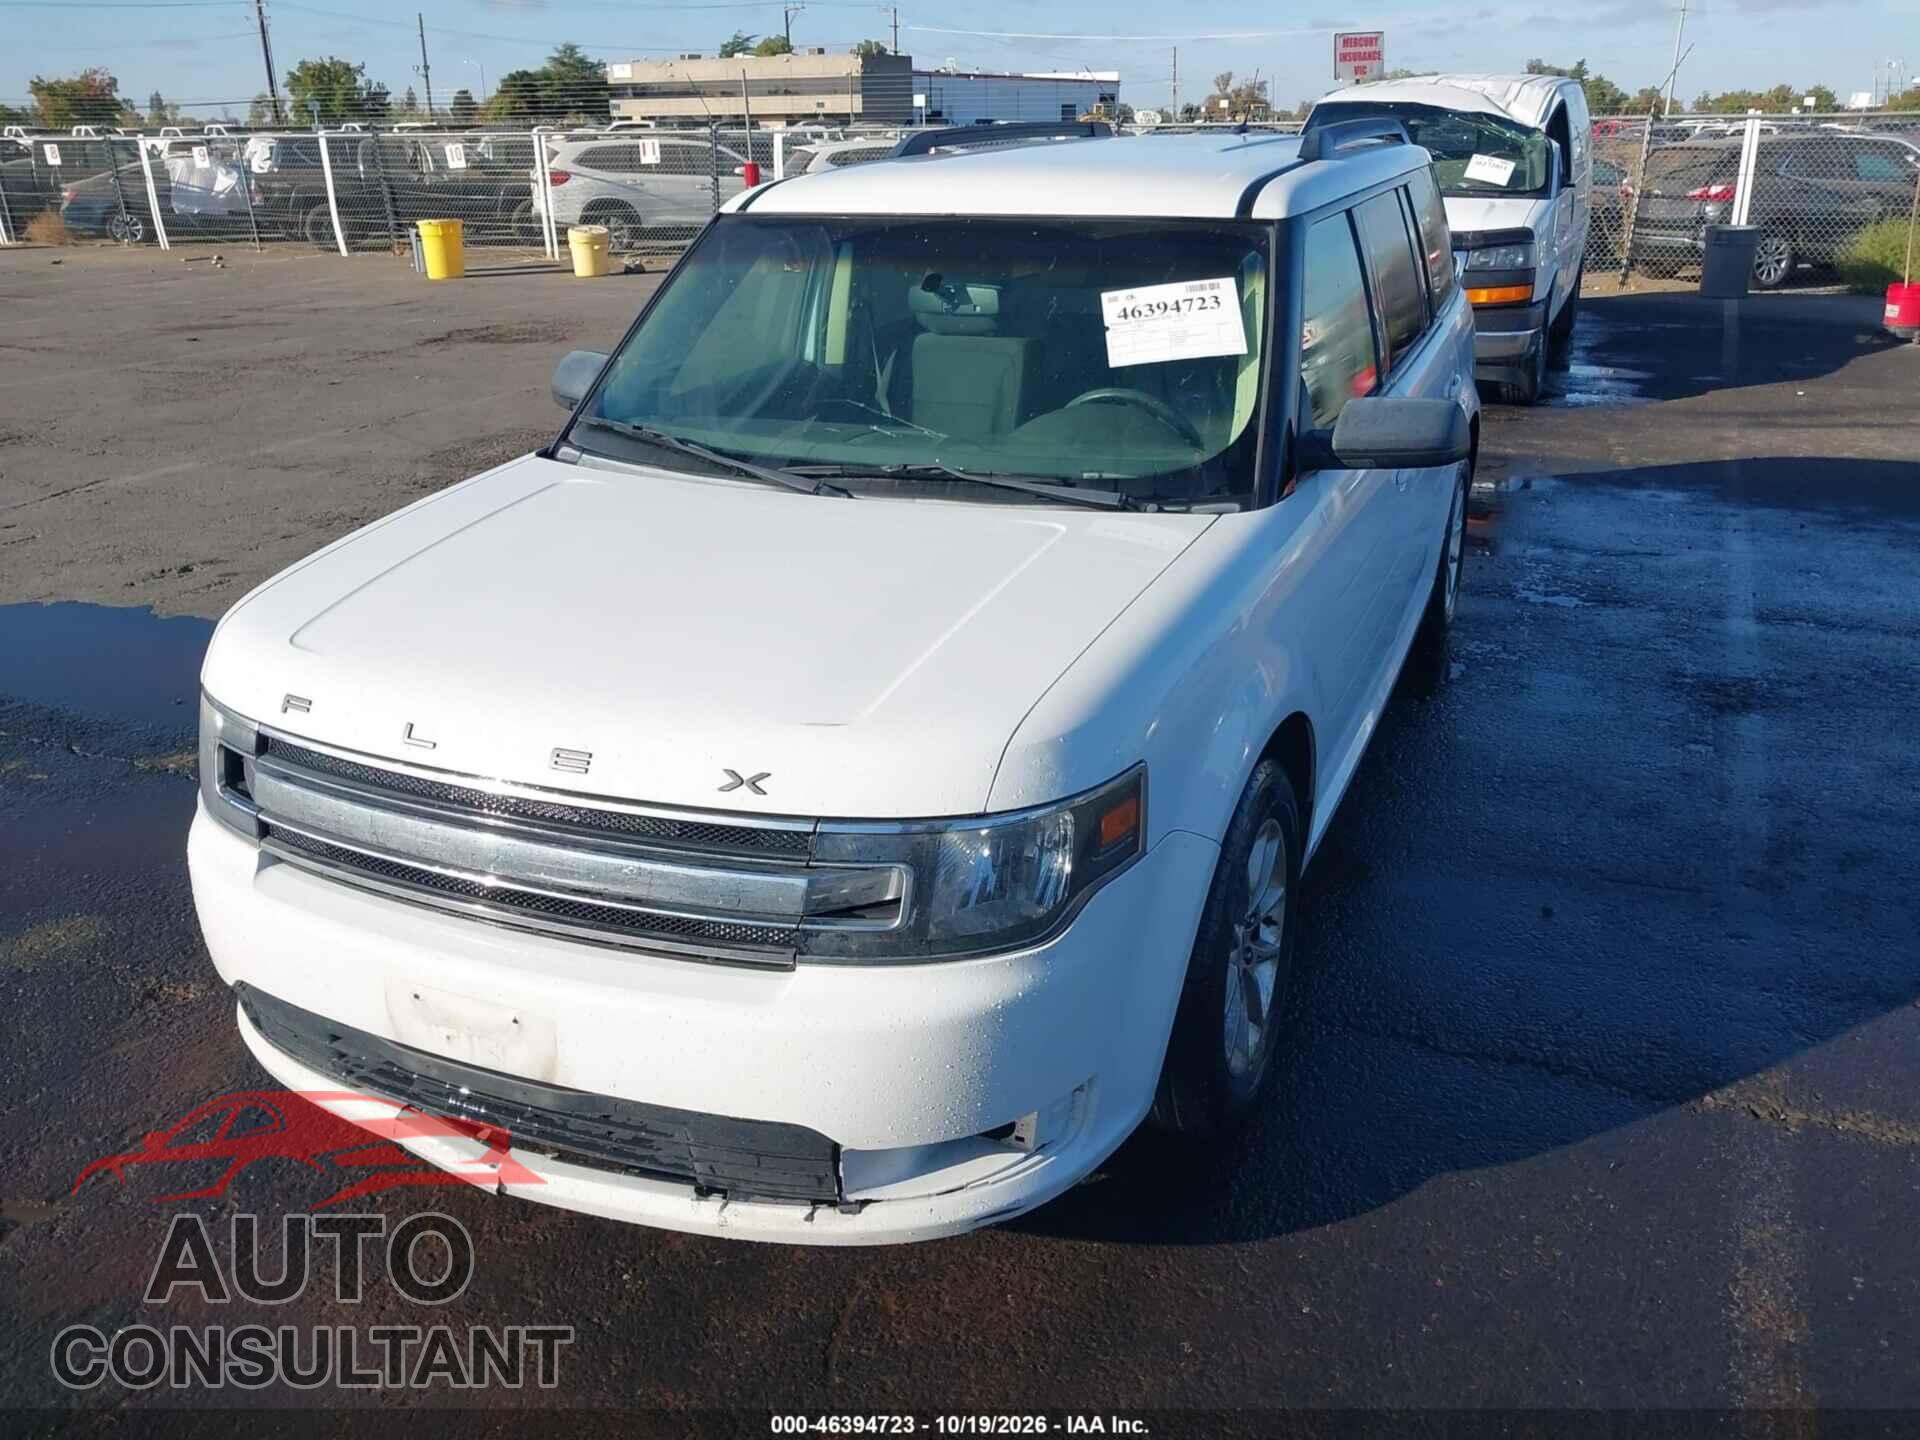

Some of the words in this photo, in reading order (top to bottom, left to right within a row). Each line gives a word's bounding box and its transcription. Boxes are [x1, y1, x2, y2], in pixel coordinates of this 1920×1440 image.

[1342, 36, 1378, 48] MERCURY
[1339, 50, 1381, 63] INSURANCE
[1353, 65, 1368, 75] VIC
[198, 148, 207, 162] 9
[449, 146, 462, 162] 10
[1117, 294, 1222, 320] 46394723
[280, 693, 772, 796] FLEX
